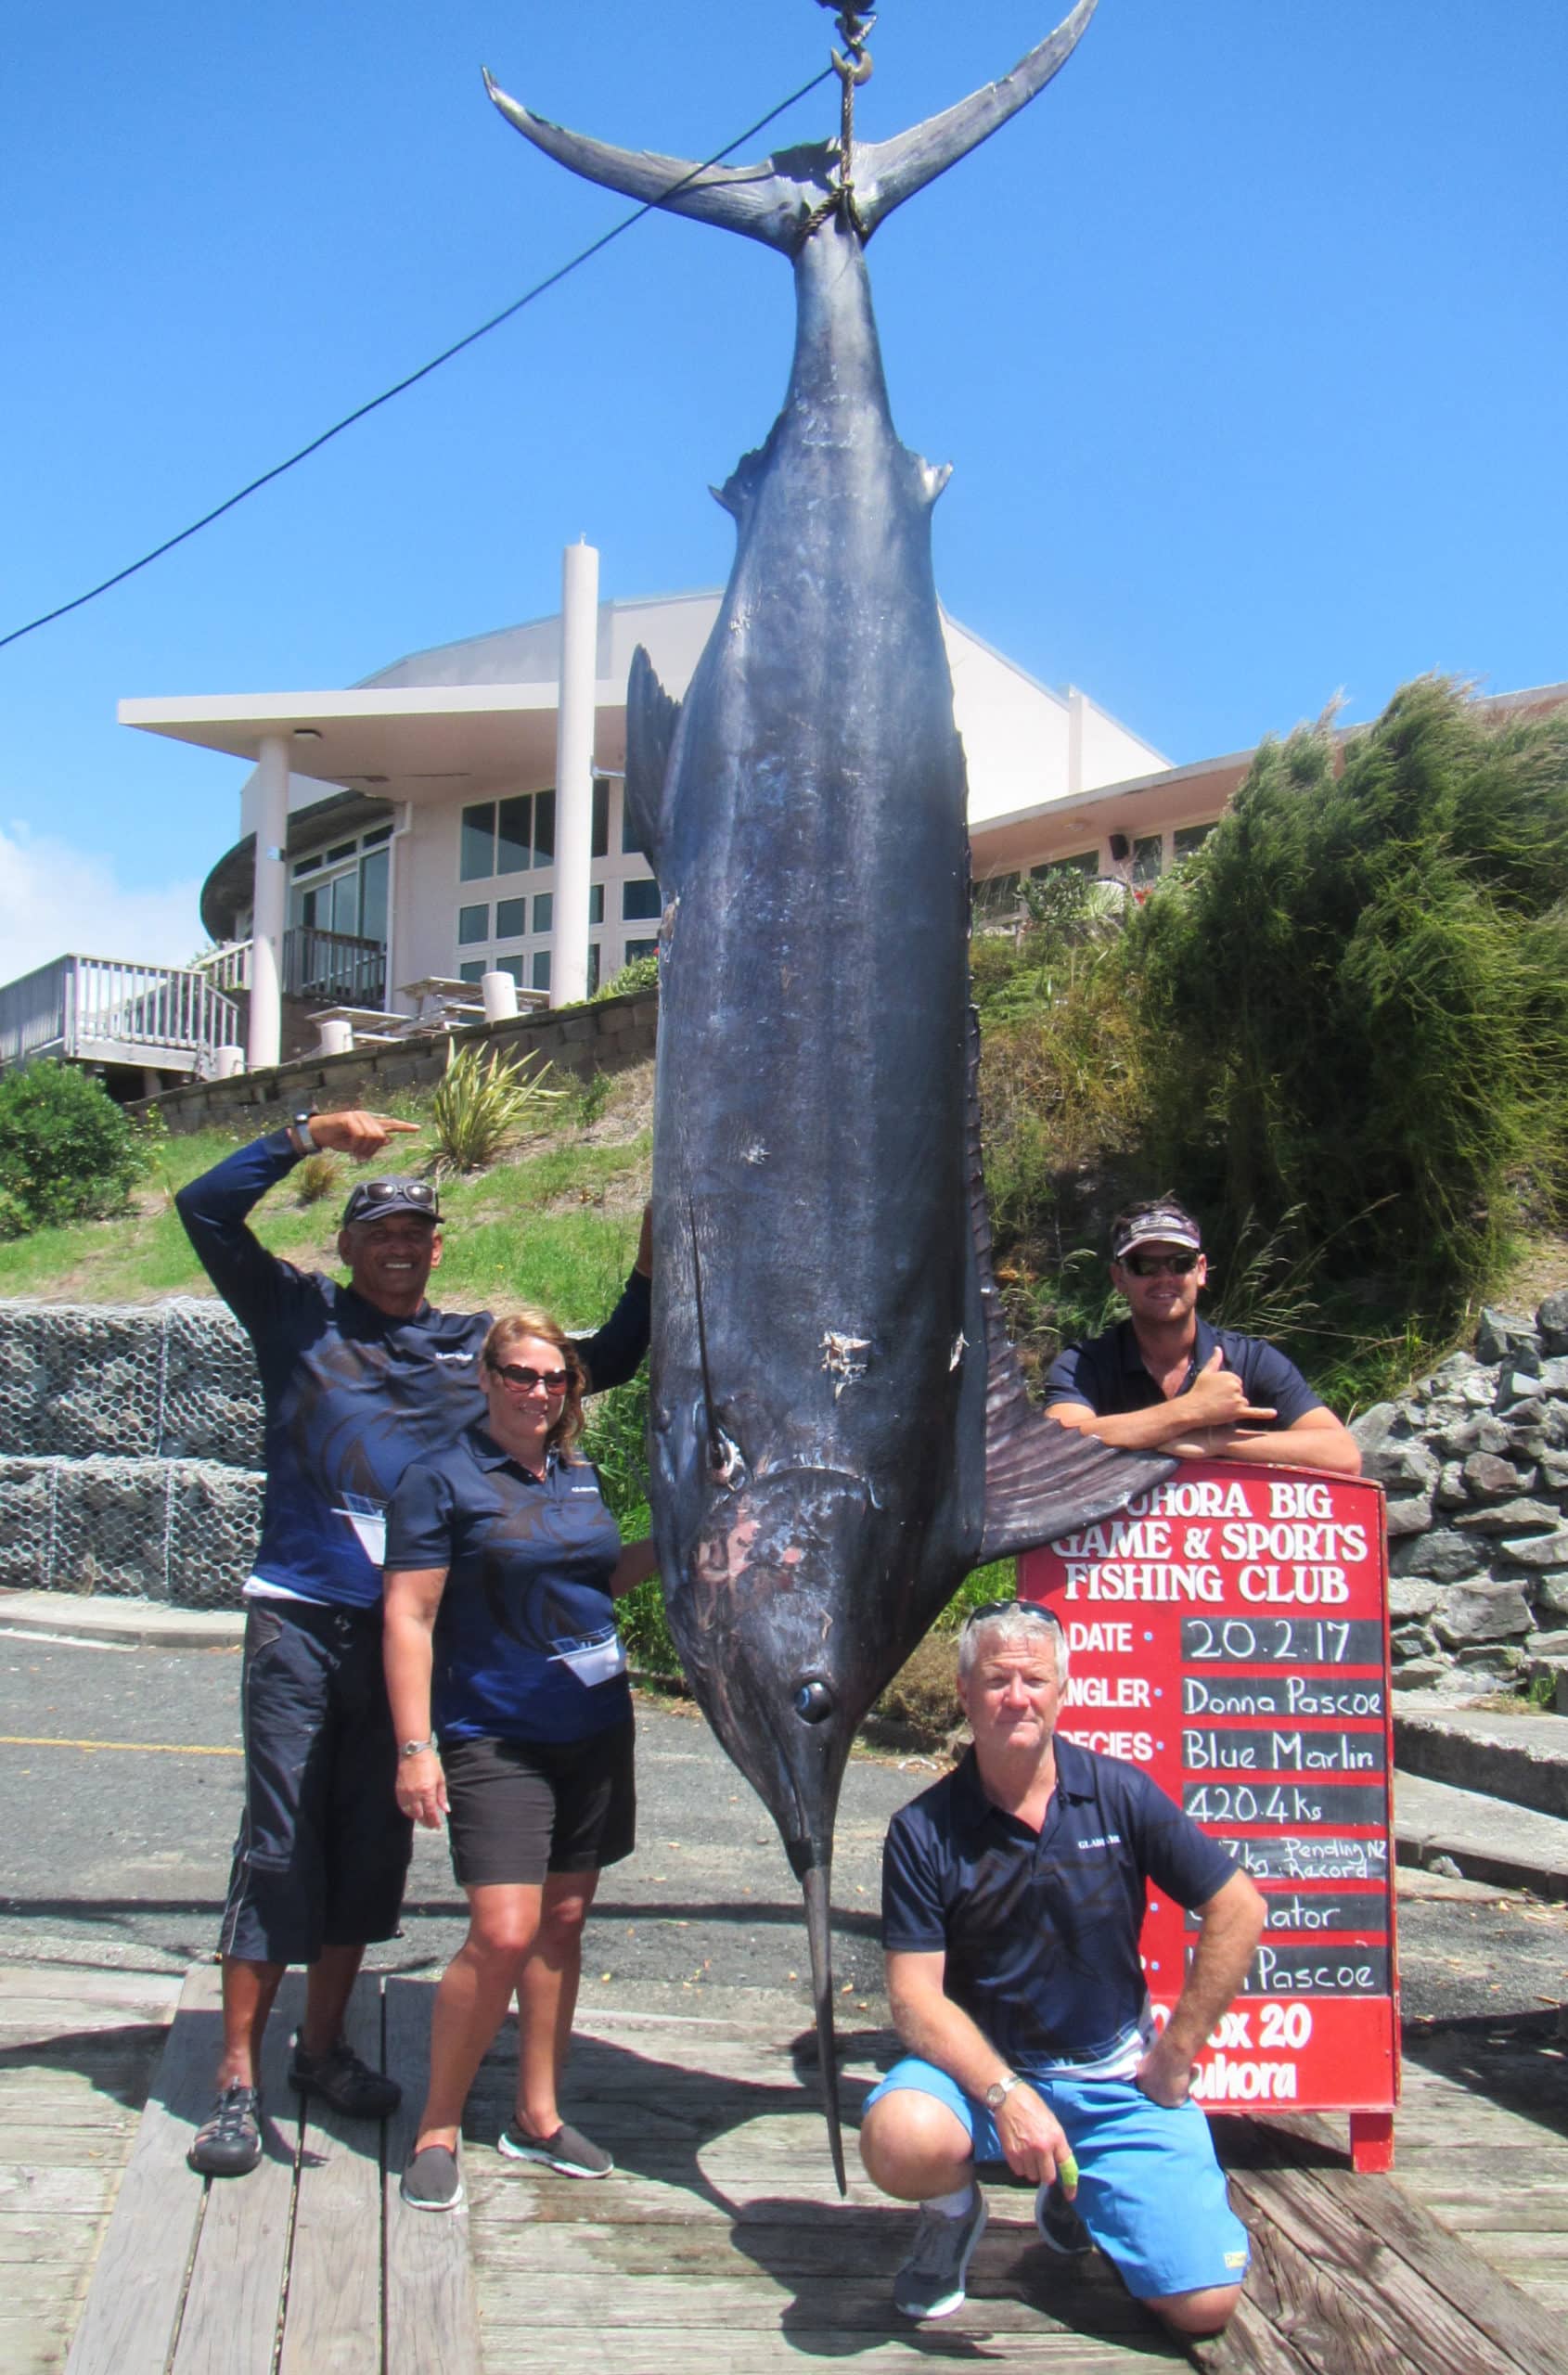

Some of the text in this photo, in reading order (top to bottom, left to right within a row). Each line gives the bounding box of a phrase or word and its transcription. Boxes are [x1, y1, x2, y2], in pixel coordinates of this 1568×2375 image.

[1268, 1482, 1333, 1519] BIG
[1051, 1521, 1368, 1562] GAME & SPORTS
[1064, 1562, 1349, 1604] FISHING CLUB
[1069, 1623, 1133, 1652] DATE
[1187, 1620, 1350, 1662] 20.2.17
[1063, 1677, 1150, 1707] NGLER
[1184, 1675, 1382, 1714] Donna Pascoe
[1182, 1730, 1373, 1770] Blue Marlin
[1279, 1837, 1367, 1866] Pending
[1255, 1945, 1374, 1990] Pascoe
[1207, 2012, 1253, 2048] ox
[1259, 2002, 1312, 2048] 20
